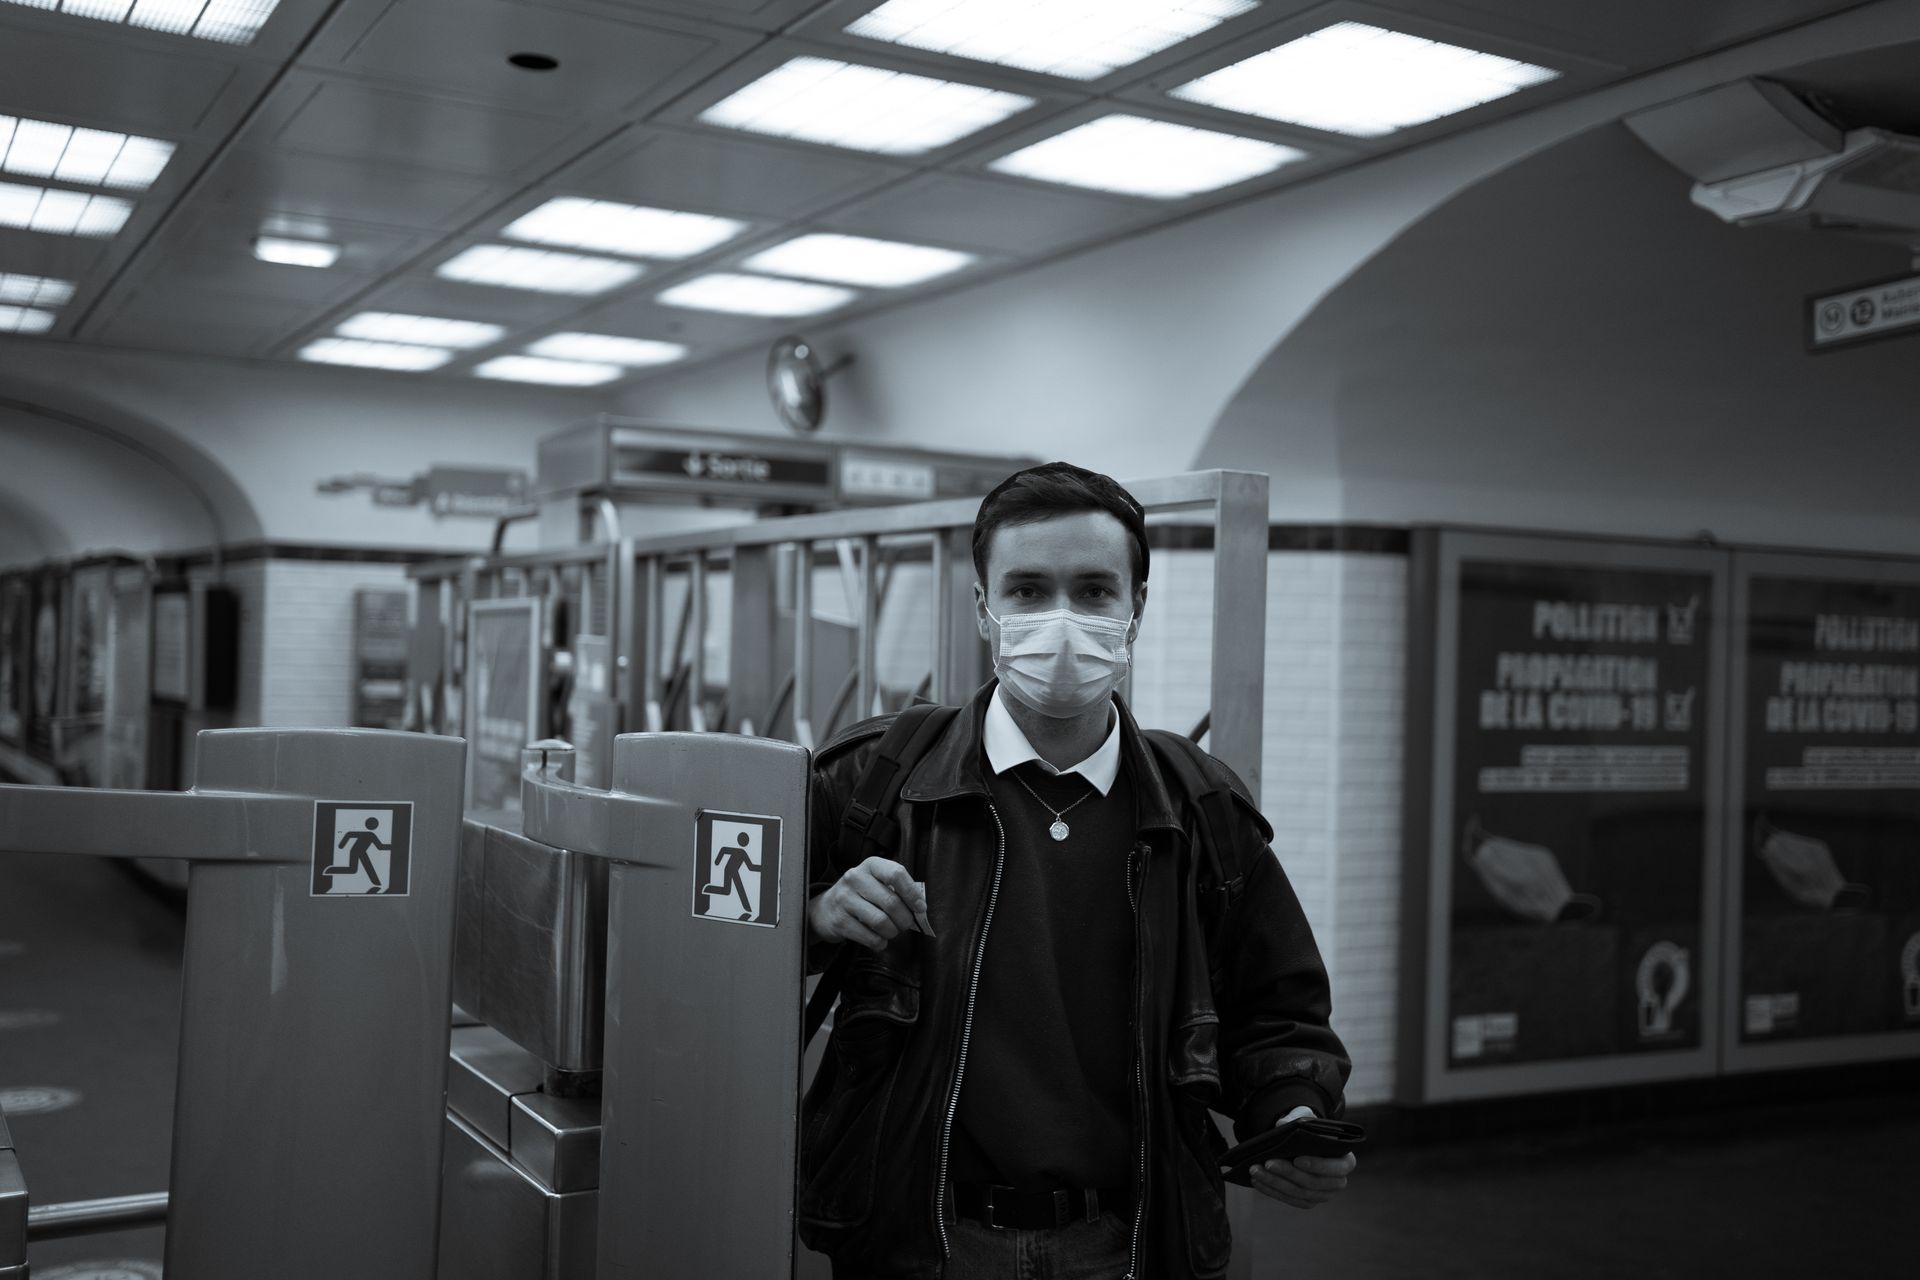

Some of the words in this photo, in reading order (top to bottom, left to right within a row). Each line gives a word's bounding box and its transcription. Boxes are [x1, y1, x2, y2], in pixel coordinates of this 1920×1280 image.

[707, 453, 771, 481] Sortie
[1533, 601, 1658, 643] POLLUTION
[1496, 652, 1658, 692] PROPAGATION
[1479, 691, 1510, 730] DE
[1513, 691, 1543, 730] LA
[1548, 692, 1658, 731] COVID-19
[1767, 697, 1794, 732] DE
[1797, 697, 1819, 732] LA
